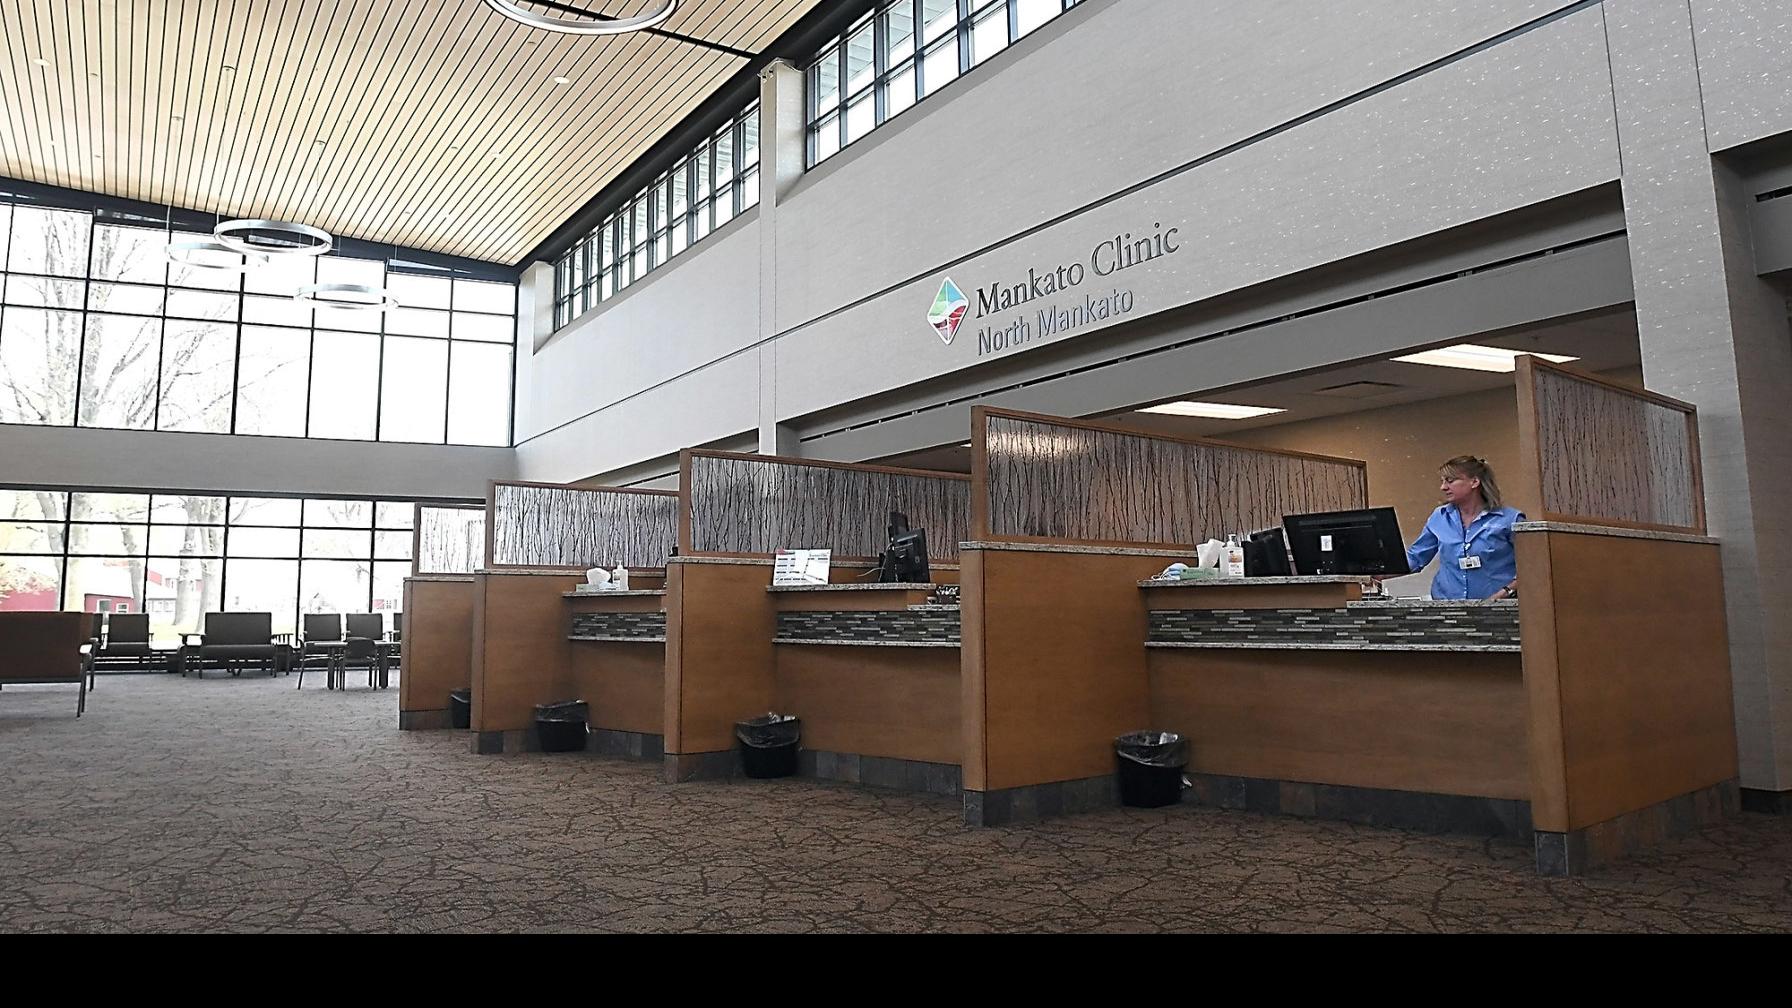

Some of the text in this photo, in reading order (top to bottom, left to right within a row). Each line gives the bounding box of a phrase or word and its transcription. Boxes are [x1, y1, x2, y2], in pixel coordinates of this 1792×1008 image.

[976, 222, 1180, 318] Mankato Clinic
[978, 289, 1134, 355] North Mankato
